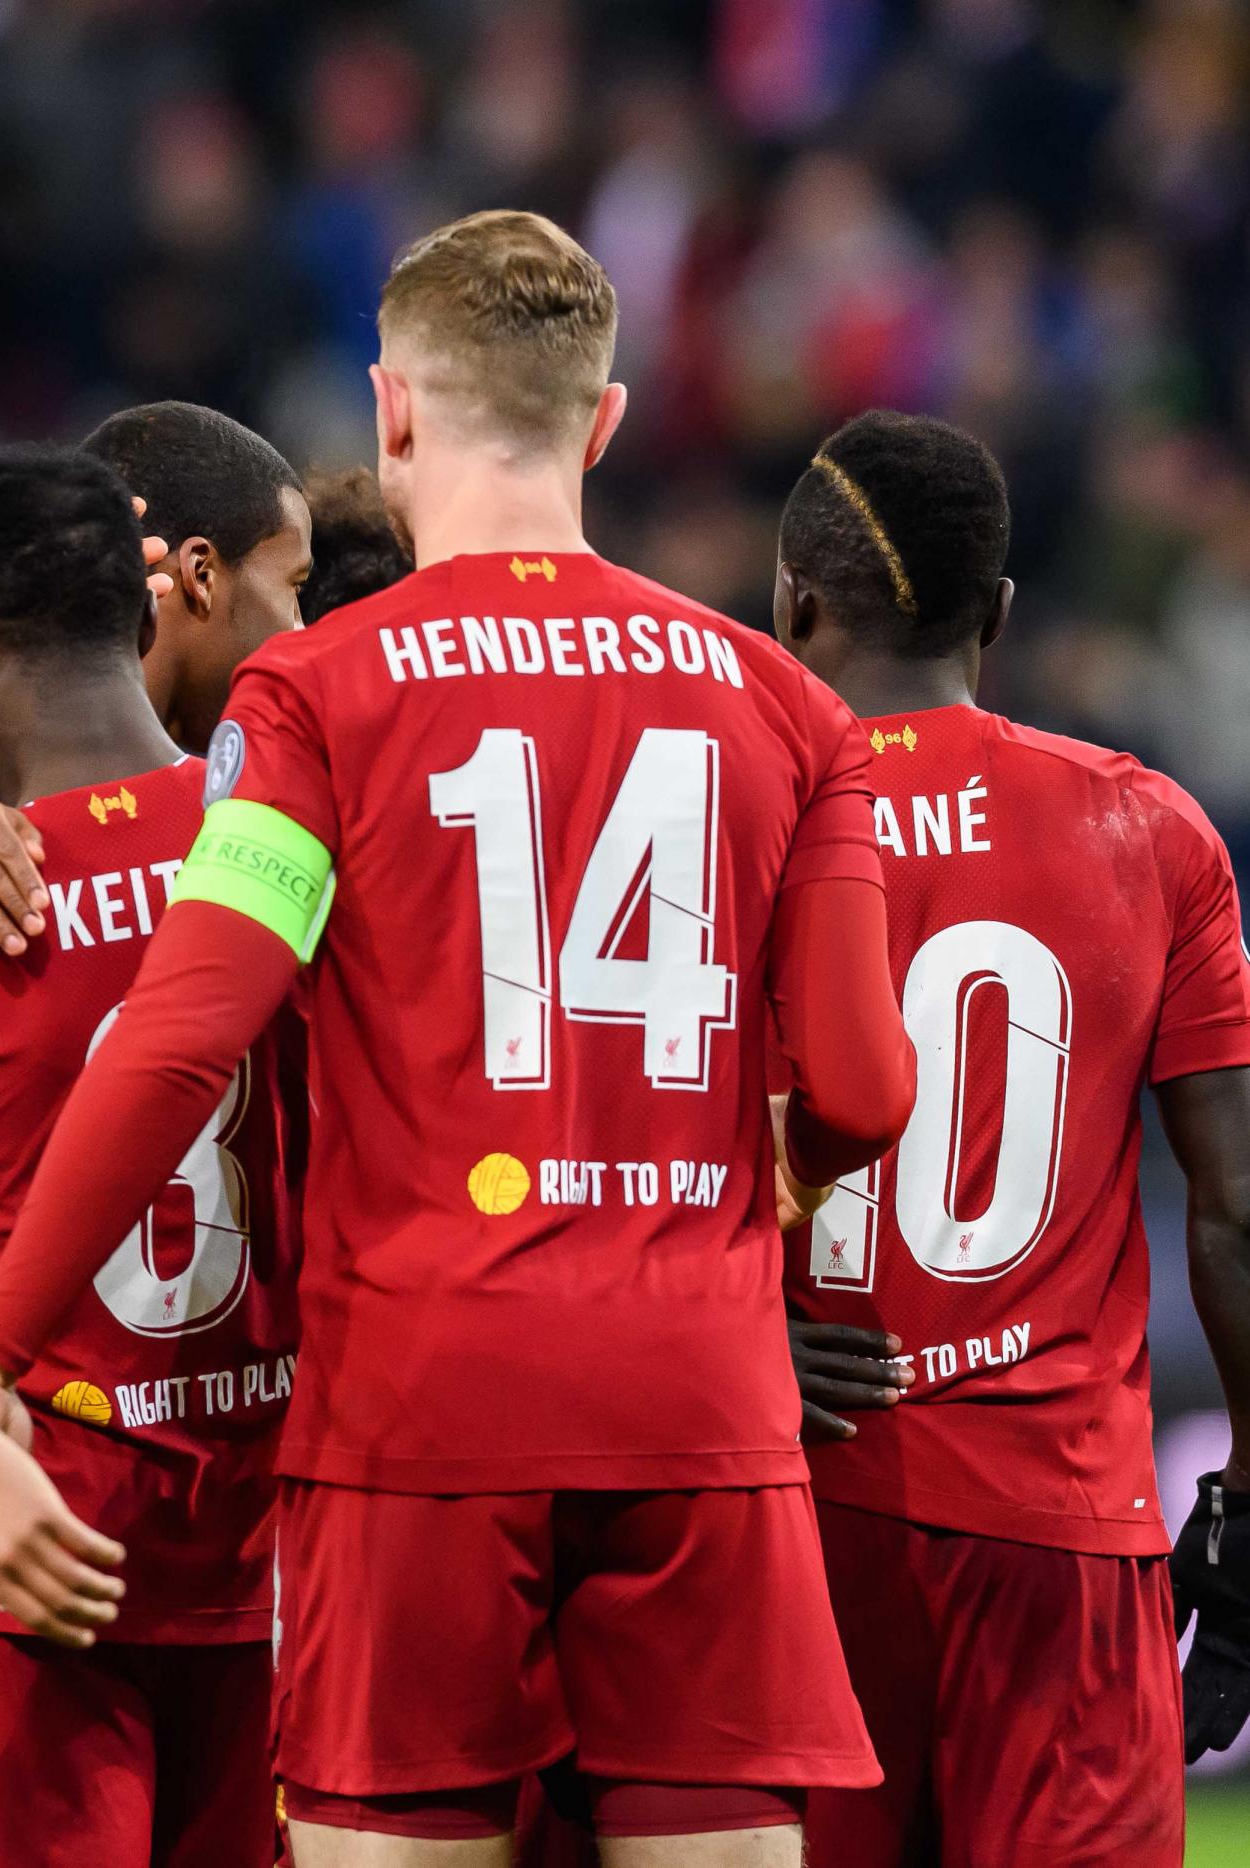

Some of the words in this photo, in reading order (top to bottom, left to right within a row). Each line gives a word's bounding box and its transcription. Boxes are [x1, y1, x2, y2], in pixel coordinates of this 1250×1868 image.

[378, 614, 745, 689] HENDERSON
[884, 733, 902, 744] 96
[872, 774, 992, 857] ANÉ
[216, 841, 318, 903] RESPECT
[48, 858, 184, 951] KEIT
[428, 728, 737, 1092] 14
[615, 1161, 659, 1207] TO
[669, 1159, 728, 1208] PLAY
[920, 1343, 957, 1383] TO
[965, 1321, 1031, 1369] PLAY
[115, 1376, 190, 1428] RIGHT
[198, 1370, 234, 1416] TO
